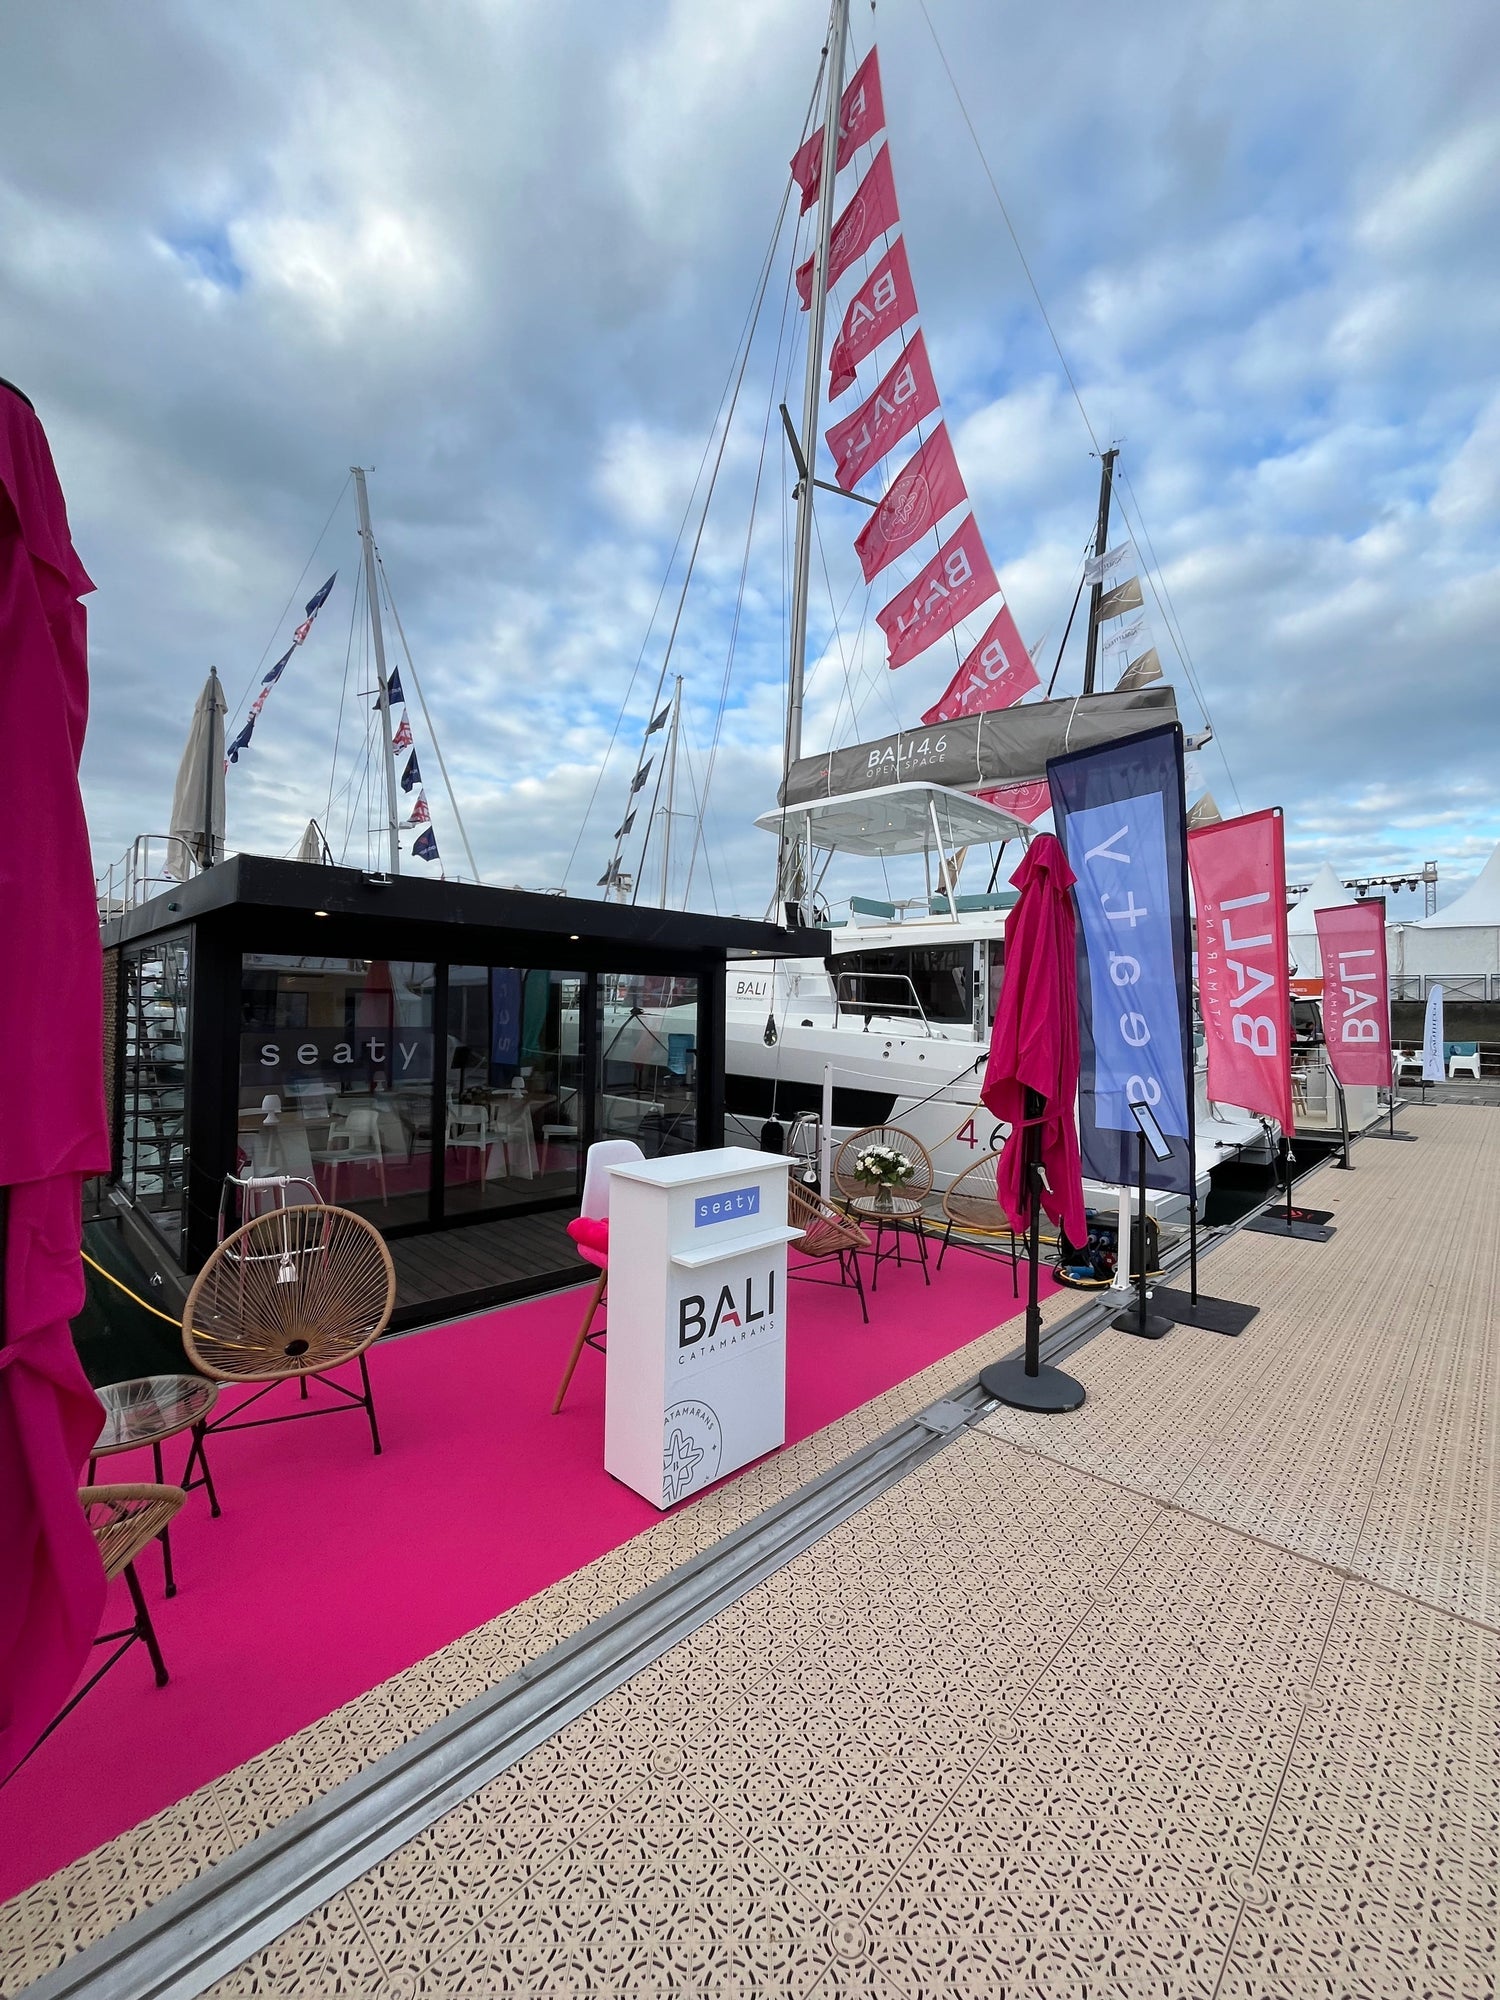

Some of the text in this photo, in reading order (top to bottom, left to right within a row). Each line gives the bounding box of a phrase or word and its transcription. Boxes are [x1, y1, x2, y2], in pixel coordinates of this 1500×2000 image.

[866, 753, 946, 778] OPEN SPACE
[867, 734, 947, 769] BALI 4.6
[736, 981, 767, 996] BALI
[260, 1036, 419, 1071] seaty
[956, 1118, 1007, 1152] 4.6
[700, 1194, 756, 1217] seaty
[679, 1270, 775, 1349] BALI
[678, 1320, 775, 1365] CATAMARANS
[663, 1406, 715, 1431] ATAMARANS
